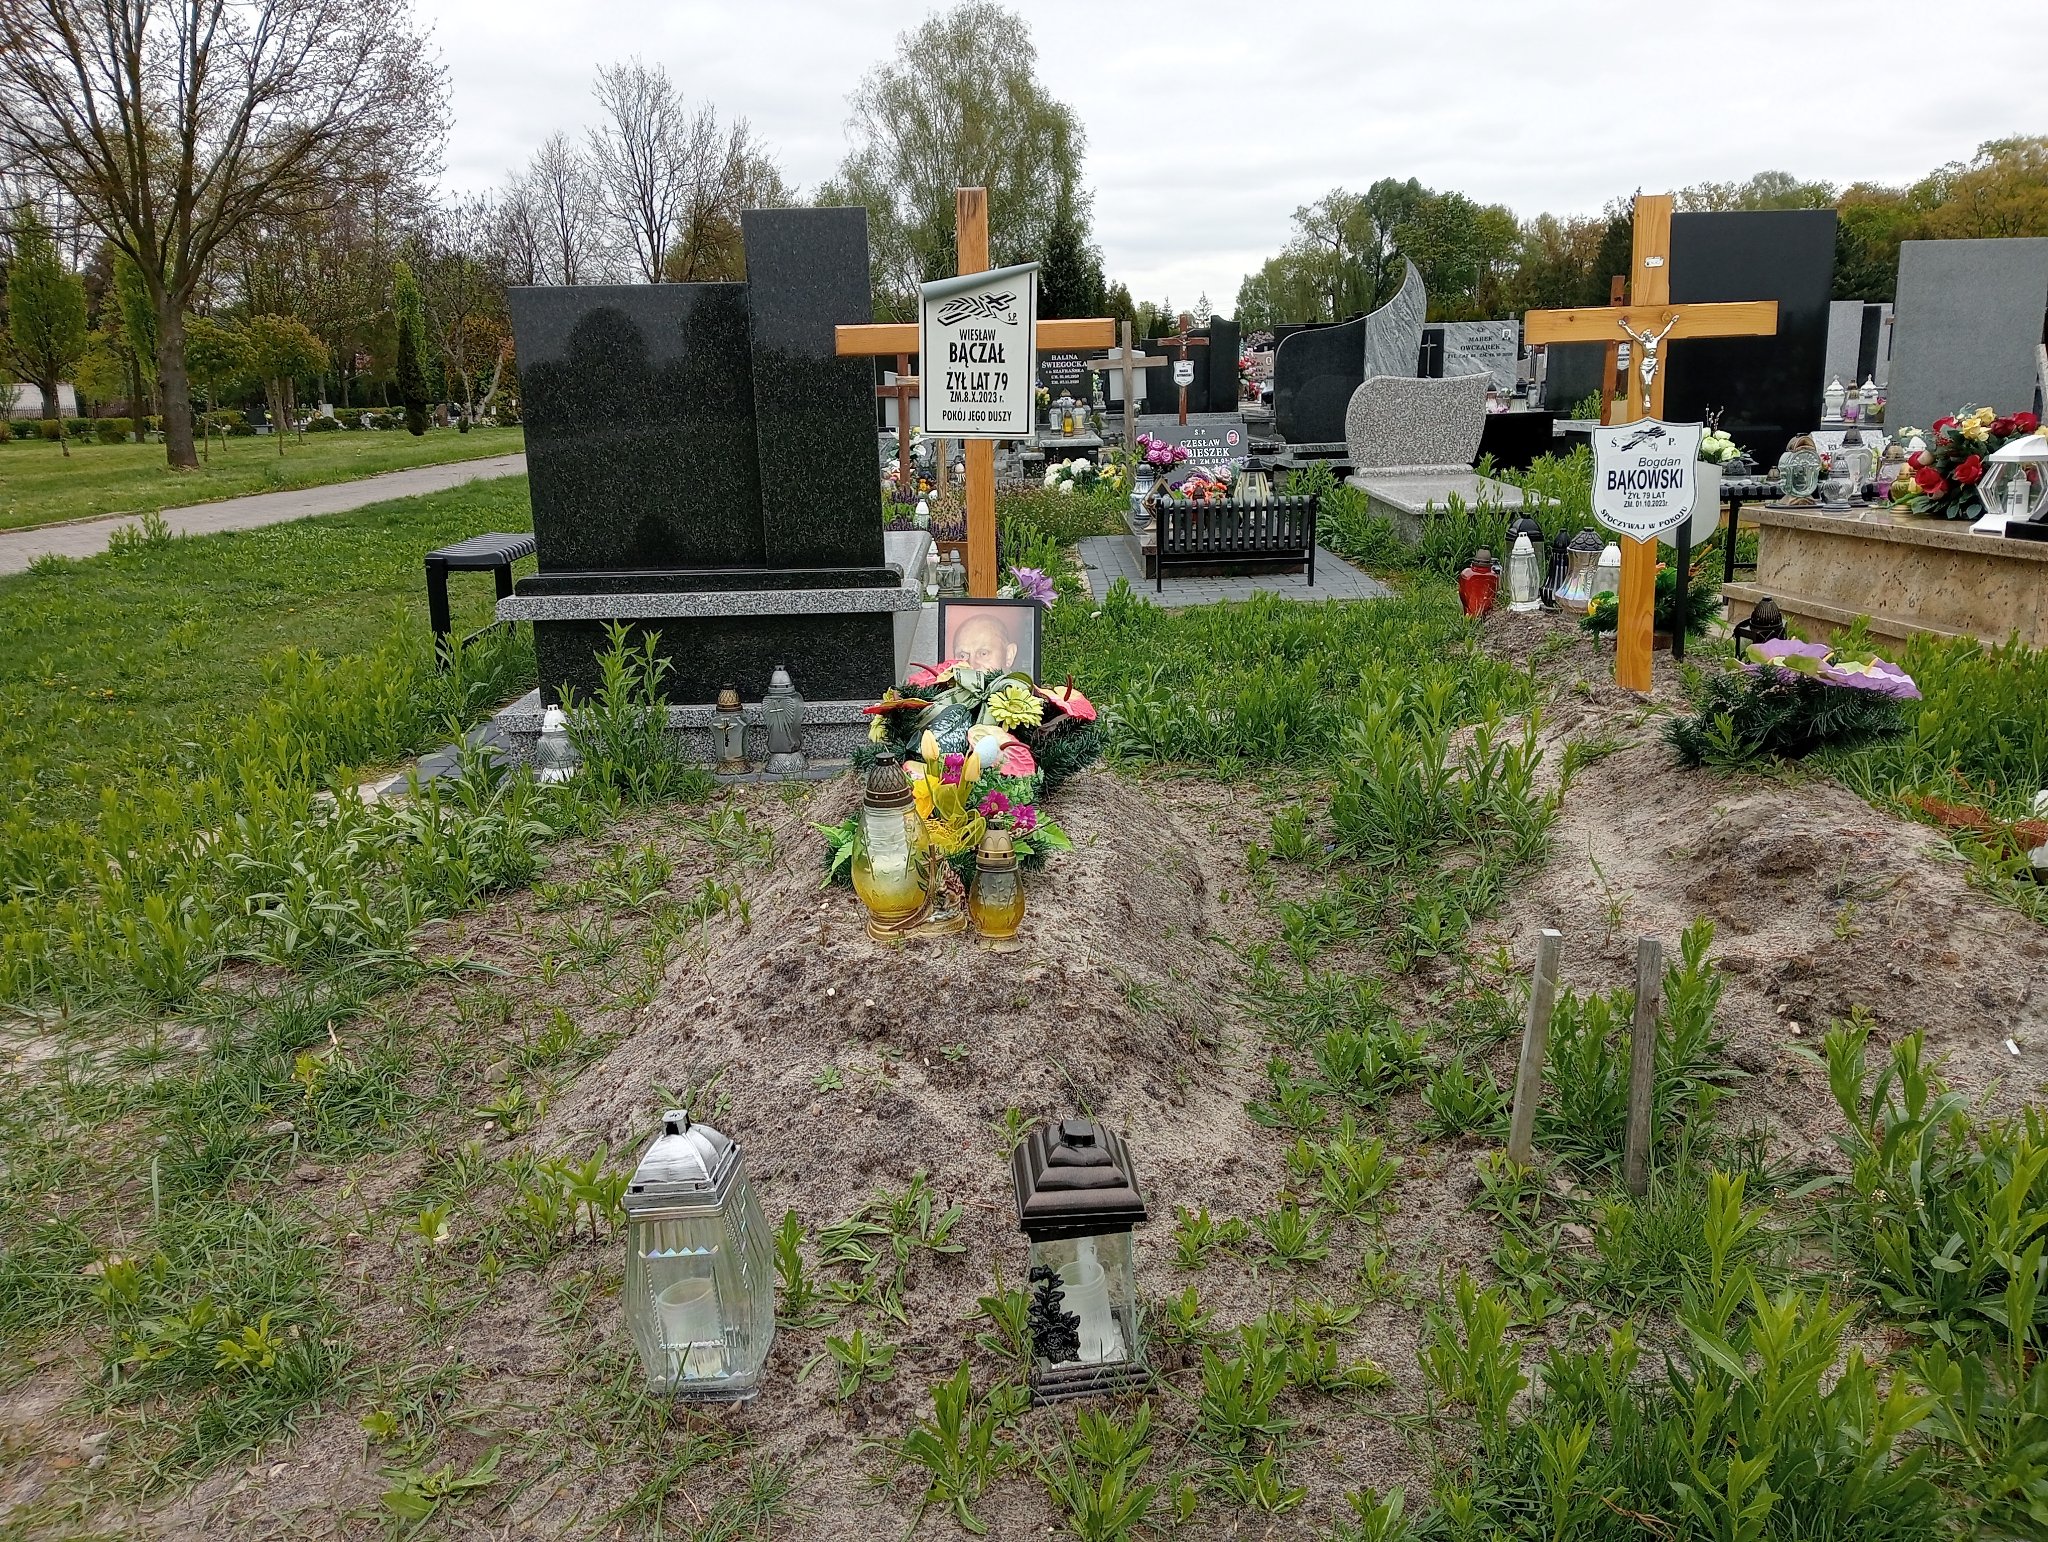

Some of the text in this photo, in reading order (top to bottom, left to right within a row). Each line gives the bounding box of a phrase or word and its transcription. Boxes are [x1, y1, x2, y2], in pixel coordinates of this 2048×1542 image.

[959, 329, 996, 341] WIESŁAW
[950, 342, 1006, 368] BĄCZAŁ
[946, 366, 1008, 390] ŻYŁ LAT 79
[950, 391, 997, 403] ZM.8.X.2023
[943, 408, 1012, 422] POKÓJ JEGO DUSZY
[1180, 439, 1220, 448] CZESŁAW
[1611, 437, 1676, 448] Ś. P.
[1639, 457, 1681, 468] Bogdan
[1607, 469, 1683, 495] BĄKOWSKI
[1628, 491, 1640, 499] ŻYŁ
[1601, 509, 1645, 530] SPOCZYWAJ
[1659, 506, 1688, 527] POKOJU
